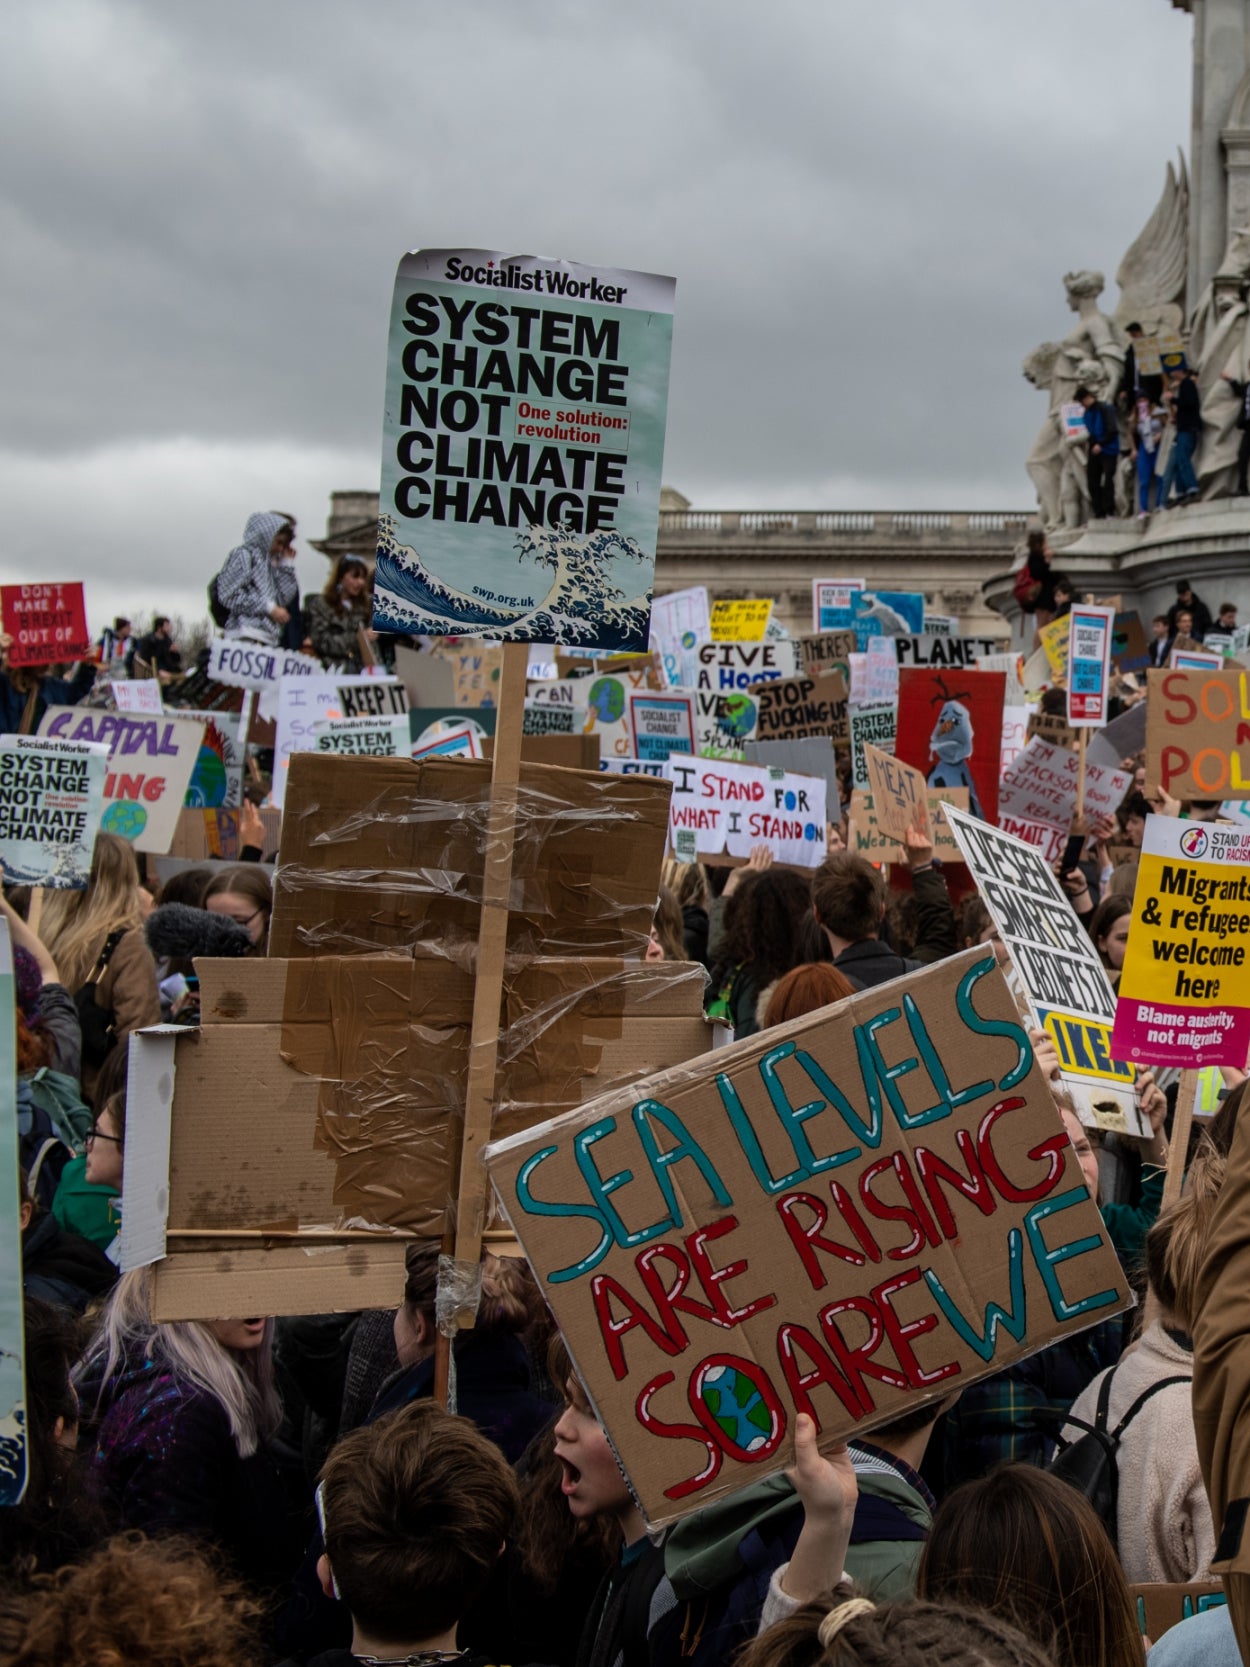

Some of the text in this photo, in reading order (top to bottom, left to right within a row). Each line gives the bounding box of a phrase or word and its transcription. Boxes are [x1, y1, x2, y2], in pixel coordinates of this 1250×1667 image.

[445, 257, 627, 303] Socialist Worker
[402, 293, 620, 361] SYSTEM
[402, 339, 629, 406] CHANGE
[400, 385, 511, 436] NOT
[518, 402, 628, 430] One solution:
[517, 422, 601, 445] revolution
[396, 431, 628, 495] CLIMATE
[394, 477, 619, 534] CHANGE
[13, 598, 65, 613] MAKE A
[471, 584, 536, 609] swp.org.uk
[714, 603, 731, 612] WE
[20, 611, 73, 628] BREXIT
[18, 627, 73, 644] OUT OF
[218, 648, 276, 681] FOSSIL
[698, 644, 777, 667] GIVE
[896, 637, 995, 666] PLANET
[698, 669, 711, 690] A
[338, 684, 409, 717] KEEP IT
[754, 680, 815, 710] STOP
[524, 709, 574, 722] SYSTEM
[641, 710, 681, 722] SOCIALIST
[646, 722, 678, 735] CHANGE
[758, 703, 829, 731] FUCKING
[852, 711, 894, 730] SYSTEM
[17, 738, 90, 754] Socialist Worker
[46, 712, 180, 757] CAPITAL
[319, 732, 392, 750] SYSTEM
[638, 738, 690, 752] NOT CLIMATE
[853, 725, 897, 743] CHANGE
[1, 753, 88, 776] SYSTEM
[1018, 760, 1080, 793] JACKSON
[0, 770, 90, 793] CHANGE
[673, 766, 810, 812] I STAND FOR
[872, 756, 915, 803] MEAT
[1003, 772, 1064, 805] CLIMATE
[0, 788, 42, 806] NOT
[0, 805, 87, 827] CLIMATE
[671, 804, 825, 843] WHAT I STAND ON
[1211, 832, 1240, 847] STAND
[1211, 846, 1226, 861] TO
[954, 816, 1014, 884] I'VE
[998, 843, 1064, 904] SEEN
[984, 880, 1095, 959] SMARTER
[1141, 897, 1162, 927] &
[1152, 938, 1246, 967] welcome
[1012, 942, 1117, 1019] CABINETS IN
[1174, 970, 1220, 999] here
[1137, 1005, 1235, 1030] Blame austerity,
[1147, 1029, 1223, 1050] not migrants
[516, 956, 1034, 1285] SEA LEVELS
[590, 1096, 1070, 1382] ARE RISING
[635, 1185, 1120, 1501] SO ARE WE
